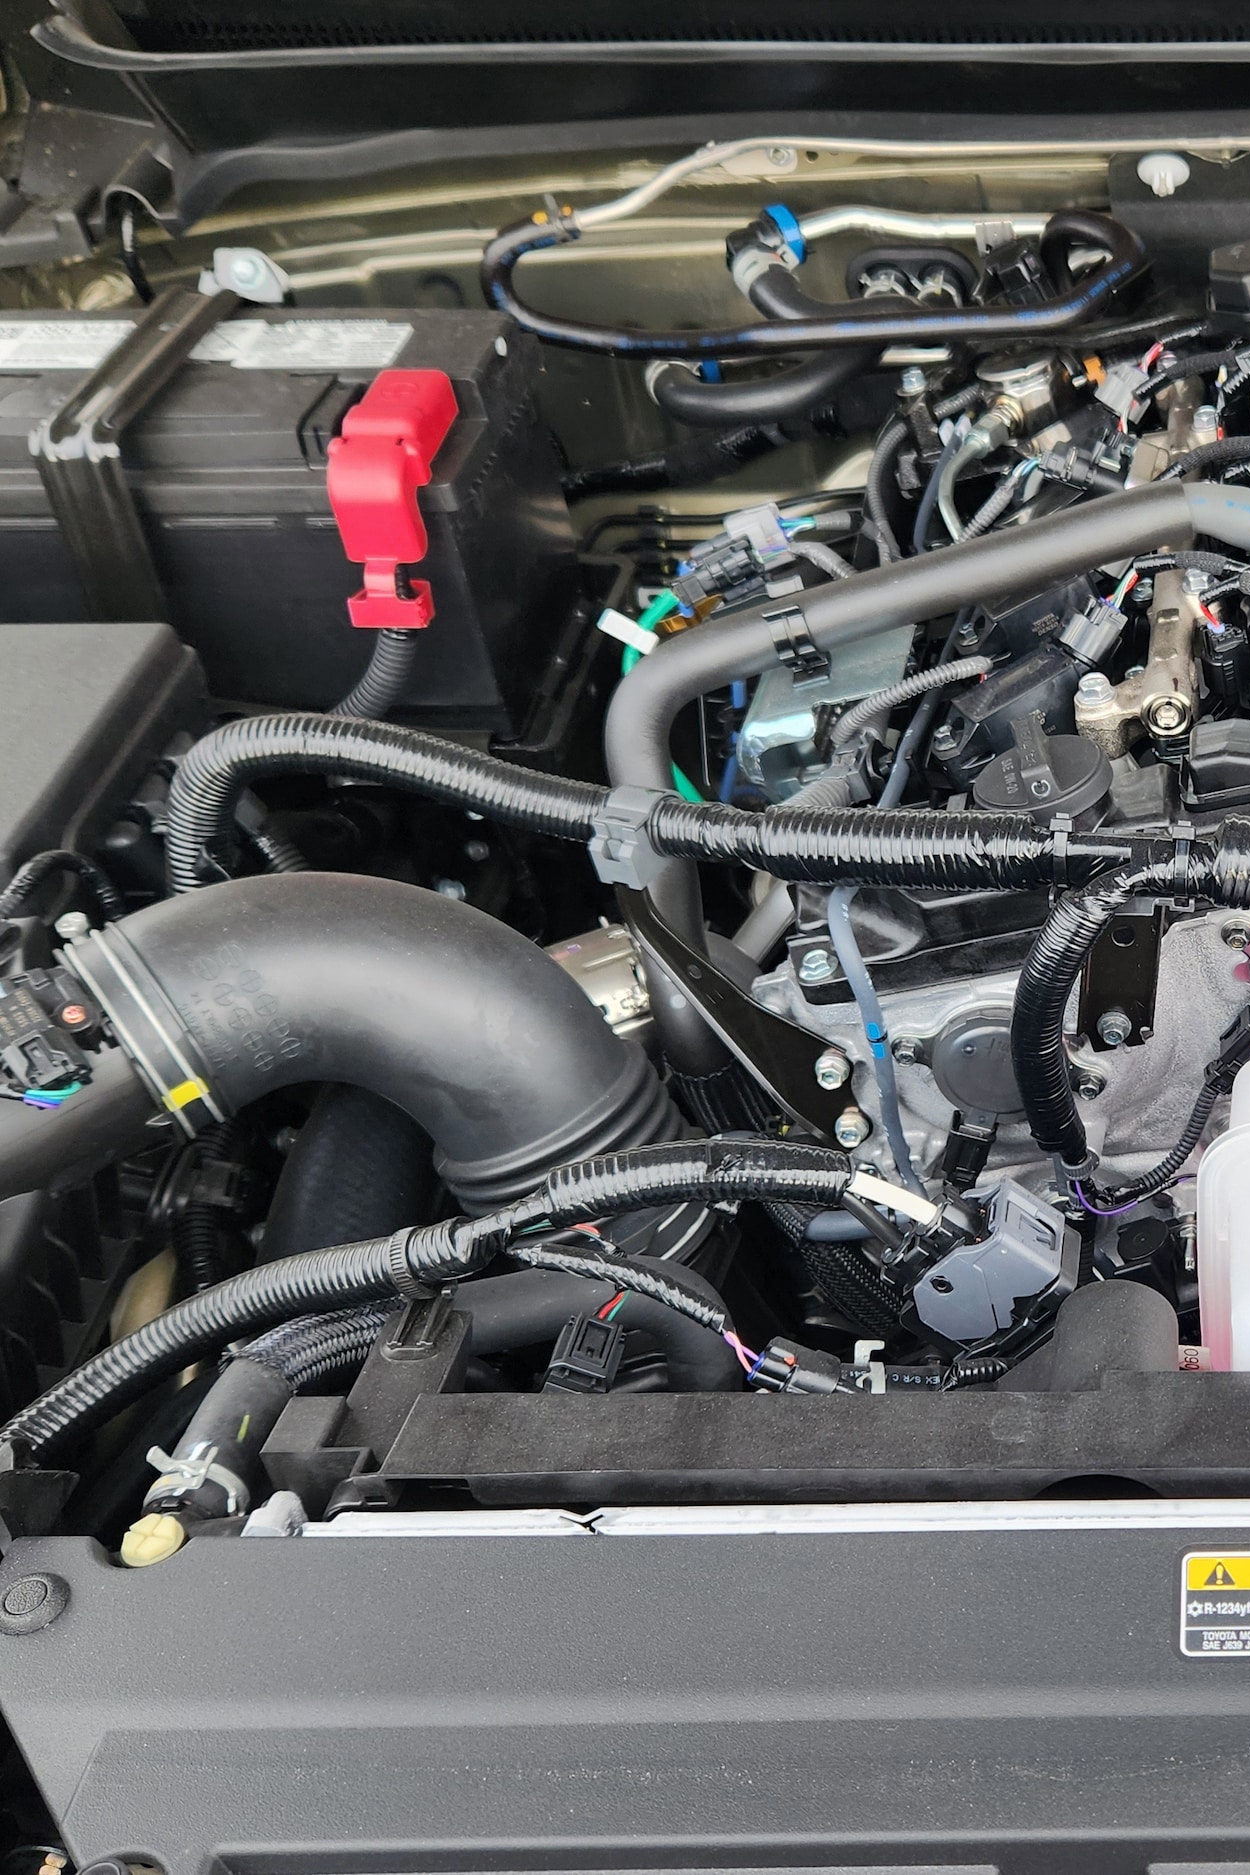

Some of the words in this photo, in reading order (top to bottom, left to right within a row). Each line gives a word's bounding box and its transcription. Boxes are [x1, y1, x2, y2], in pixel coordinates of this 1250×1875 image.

[892, 1374, 900, 1382] C
[903, 1374, 922, 1384] S/R
[1202, 1630, 1238, 1641] TOYOTA
[1202, 1640, 1221, 1650] SAE
[1222, 1640, 1244, 1650] J639
